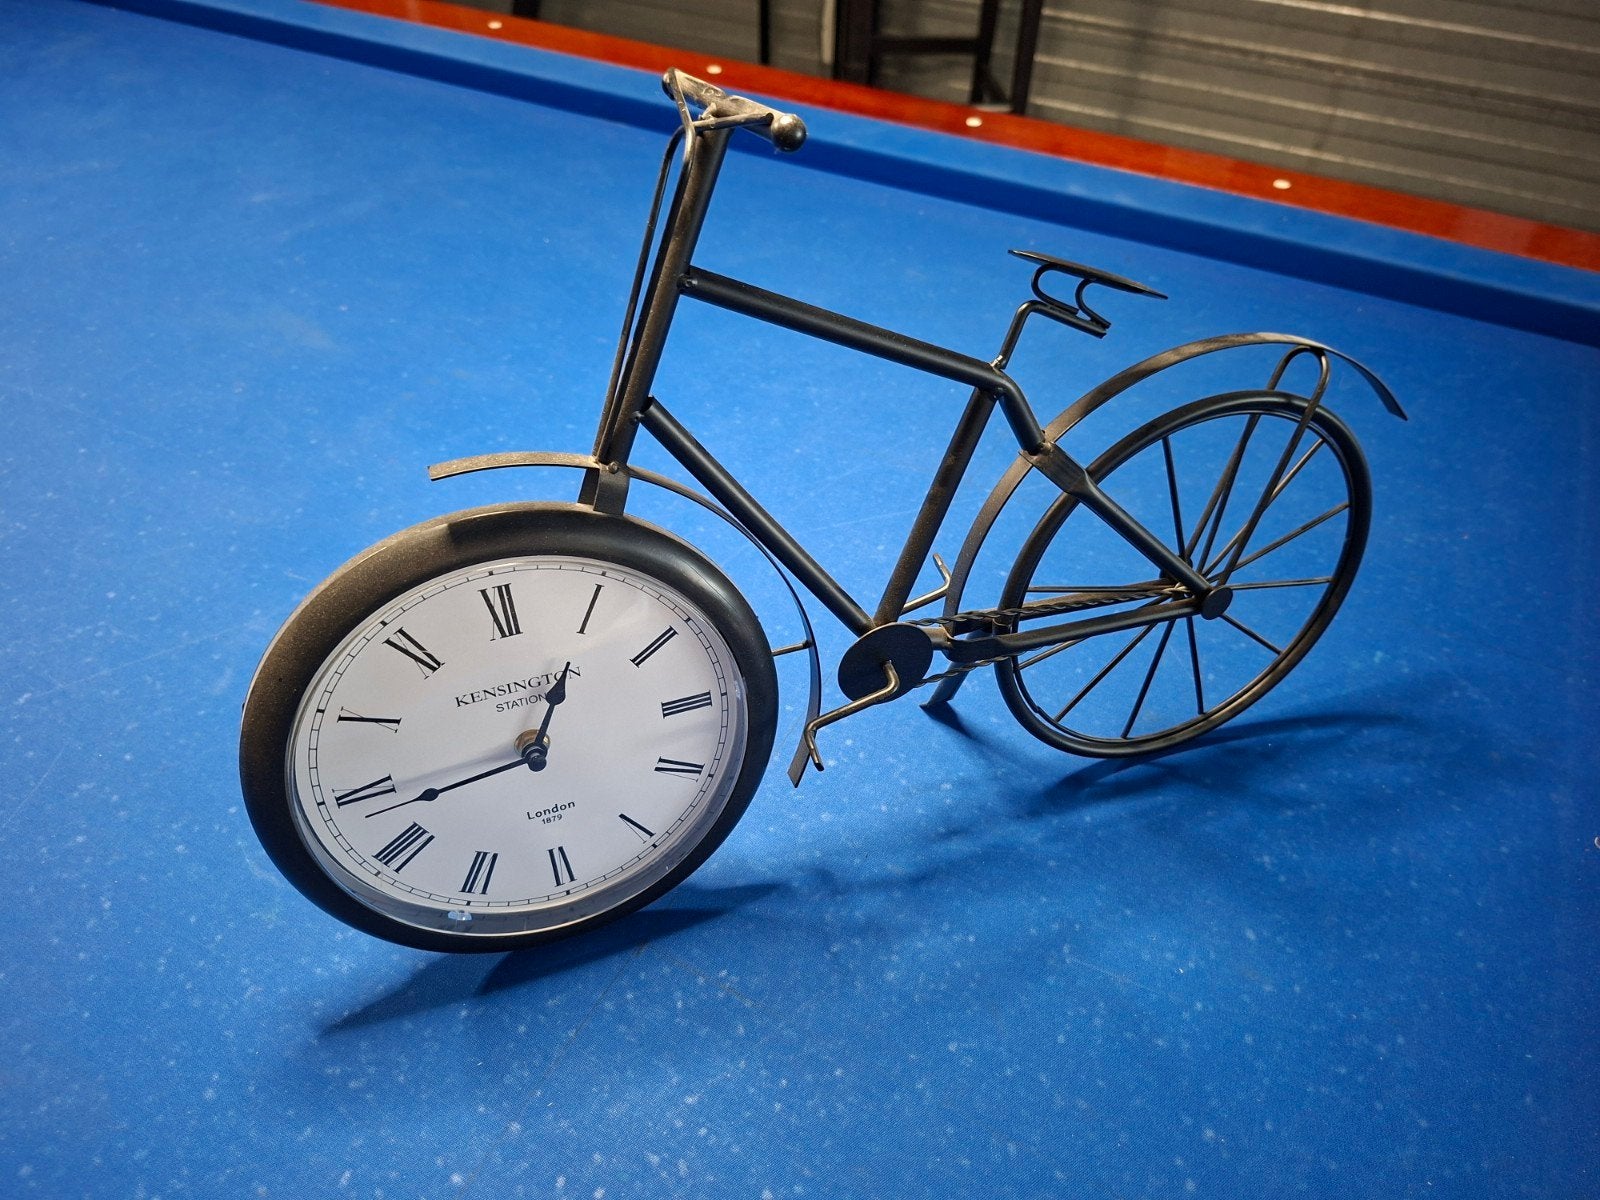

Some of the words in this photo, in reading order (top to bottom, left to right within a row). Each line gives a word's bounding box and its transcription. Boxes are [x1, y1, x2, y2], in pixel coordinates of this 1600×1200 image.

[479, 583, 523, 640] XII
[577, 584, 604, 633] I
[383, 627, 445, 679] XI
[630, 626, 677, 667] II
[337, 707, 401, 732] X
[496, 692, 547, 713] STATION
[661, 690, 712, 717] III
[655, 757, 704, 780] IV
[333, 774, 397, 808] IX
[526, 800, 576, 820] London
[541, 814, 563, 825] 1879
[619, 814, 655, 842] V
[373, 822, 434, 873] VIII
[459, 851, 498, 894] VII
[547, 846, 575, 886] VI
